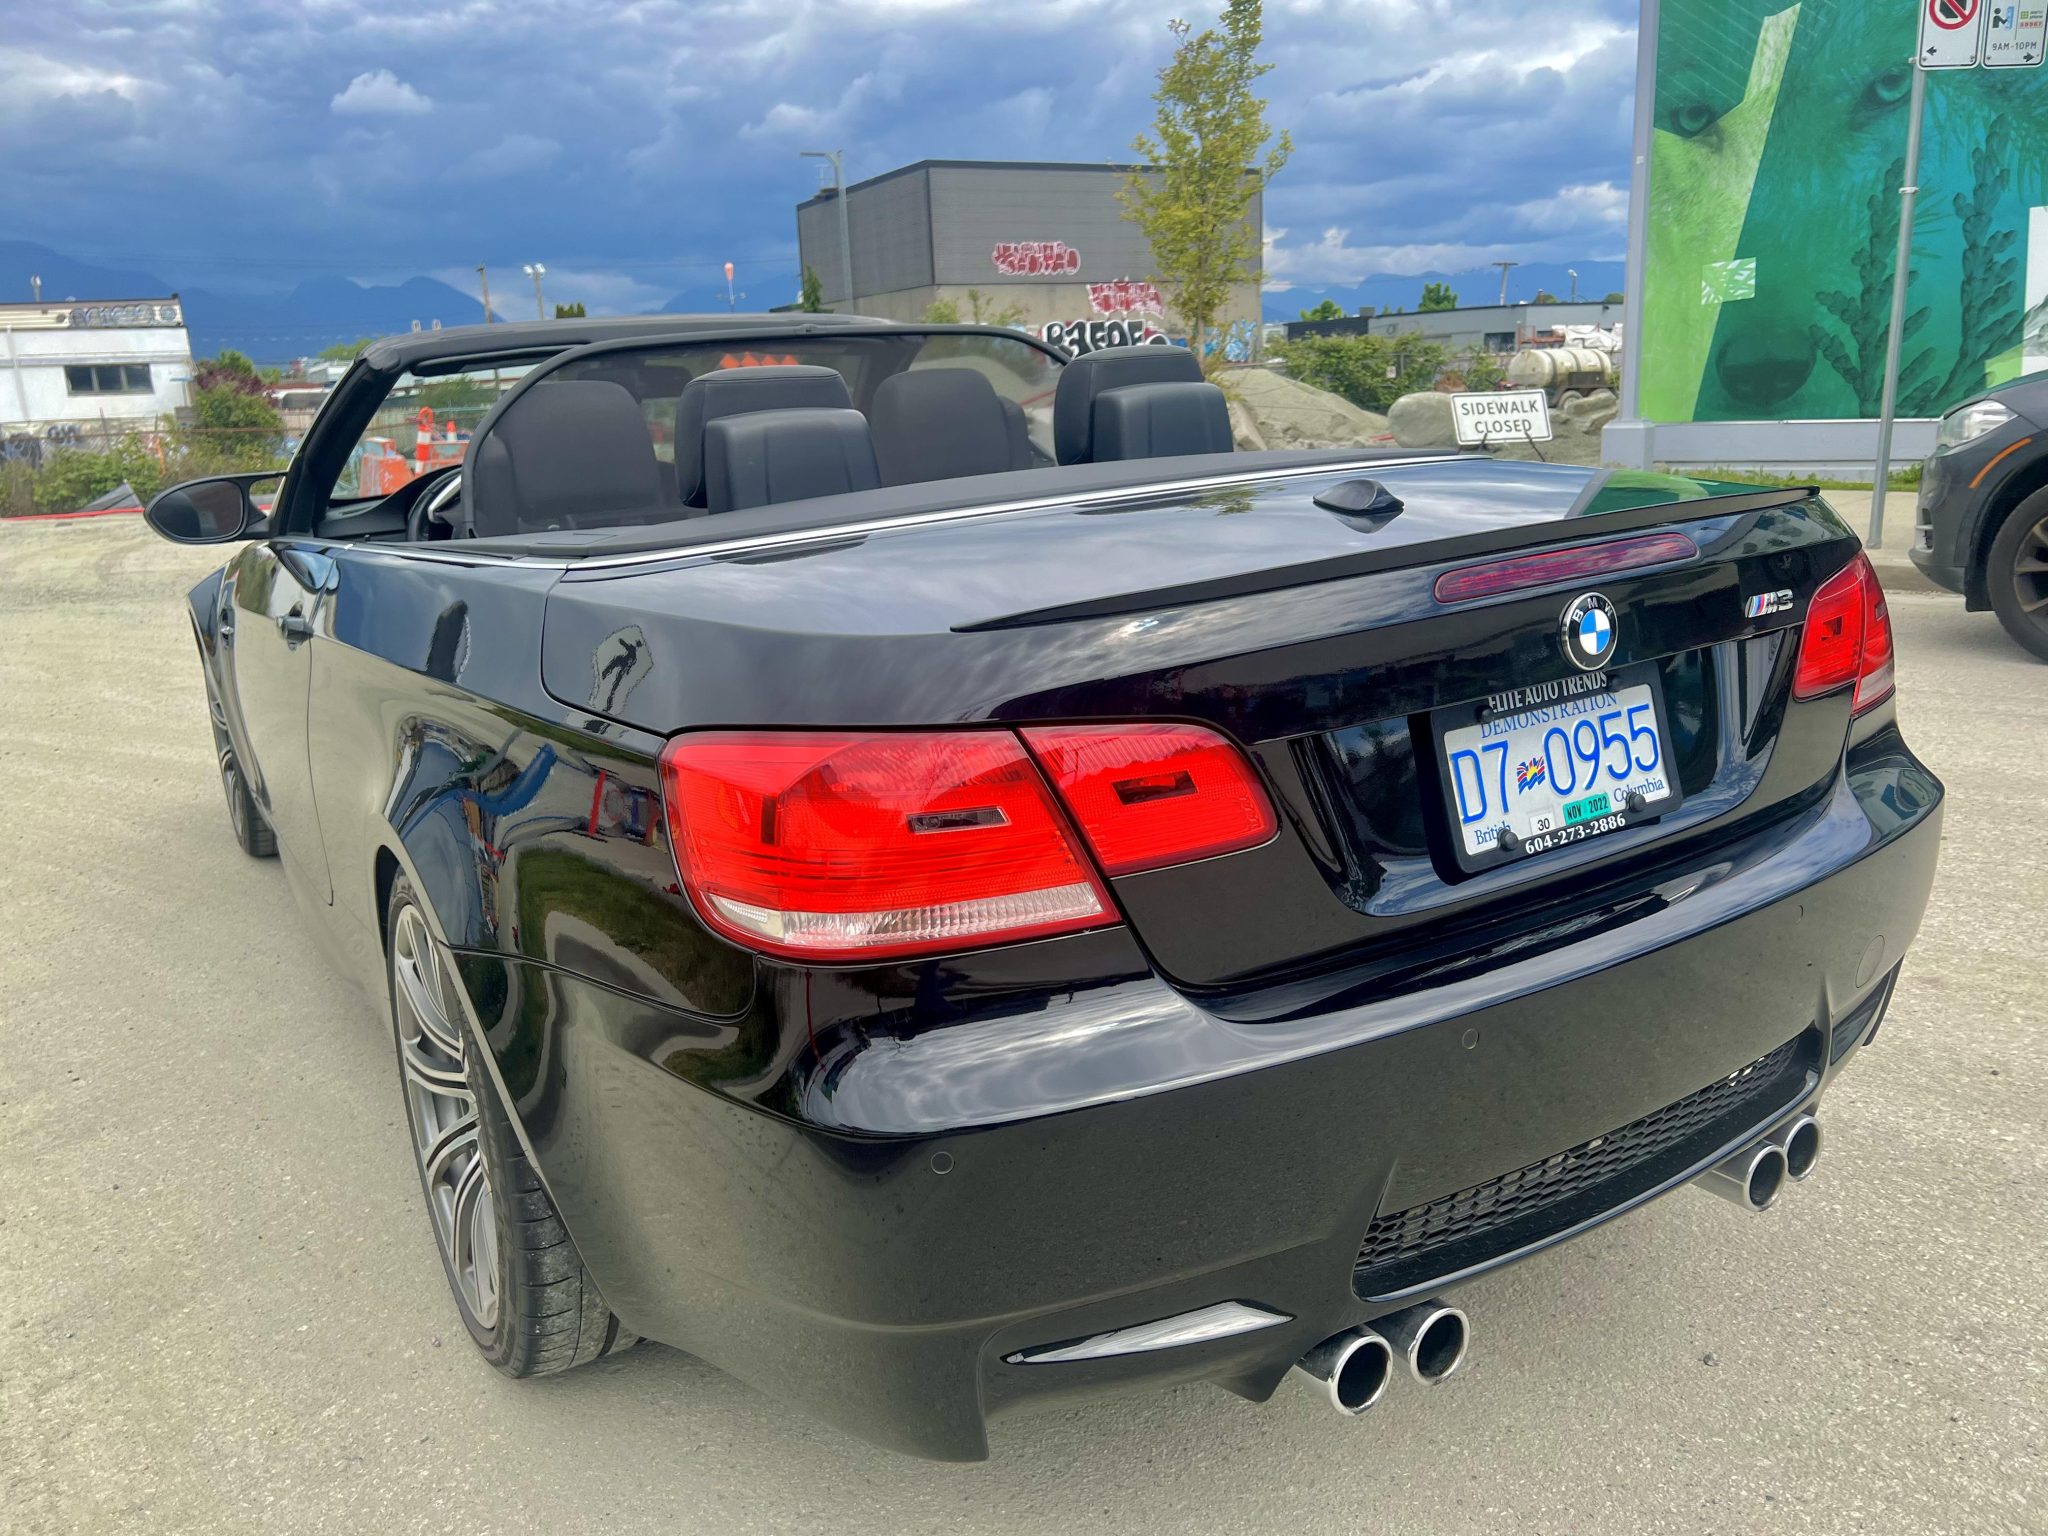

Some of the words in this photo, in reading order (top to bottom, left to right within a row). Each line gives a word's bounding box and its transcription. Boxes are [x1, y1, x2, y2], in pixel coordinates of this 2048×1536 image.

[1992, 41, 2038, 51] 9AM-10PM
[1461, 399, 1539, 416] SIDEWALK
[1474, 419, 1532, 434] CLOSED
[1572, 596, 1613, 623] BMW
[1755, 588, 1794, 616] M3
[1488, 690, 1523, 713] ELITE
[1525, 681, 1559, 706] AUTO
[1562, 671, 1608, 697] TRENDS
[1481, 692, 1617, 739] DEMONSTRATION
[1450, 740, 1509, 824] D7
[1544, 703, 1660, 796] 0955
[1567, 806, 1582, 820] NOV
[1589, 798, 1609, 814] 2022
[1525, 813, 1627, 854] 604-273-2886
[1537, 817, 1551, 831] 30
